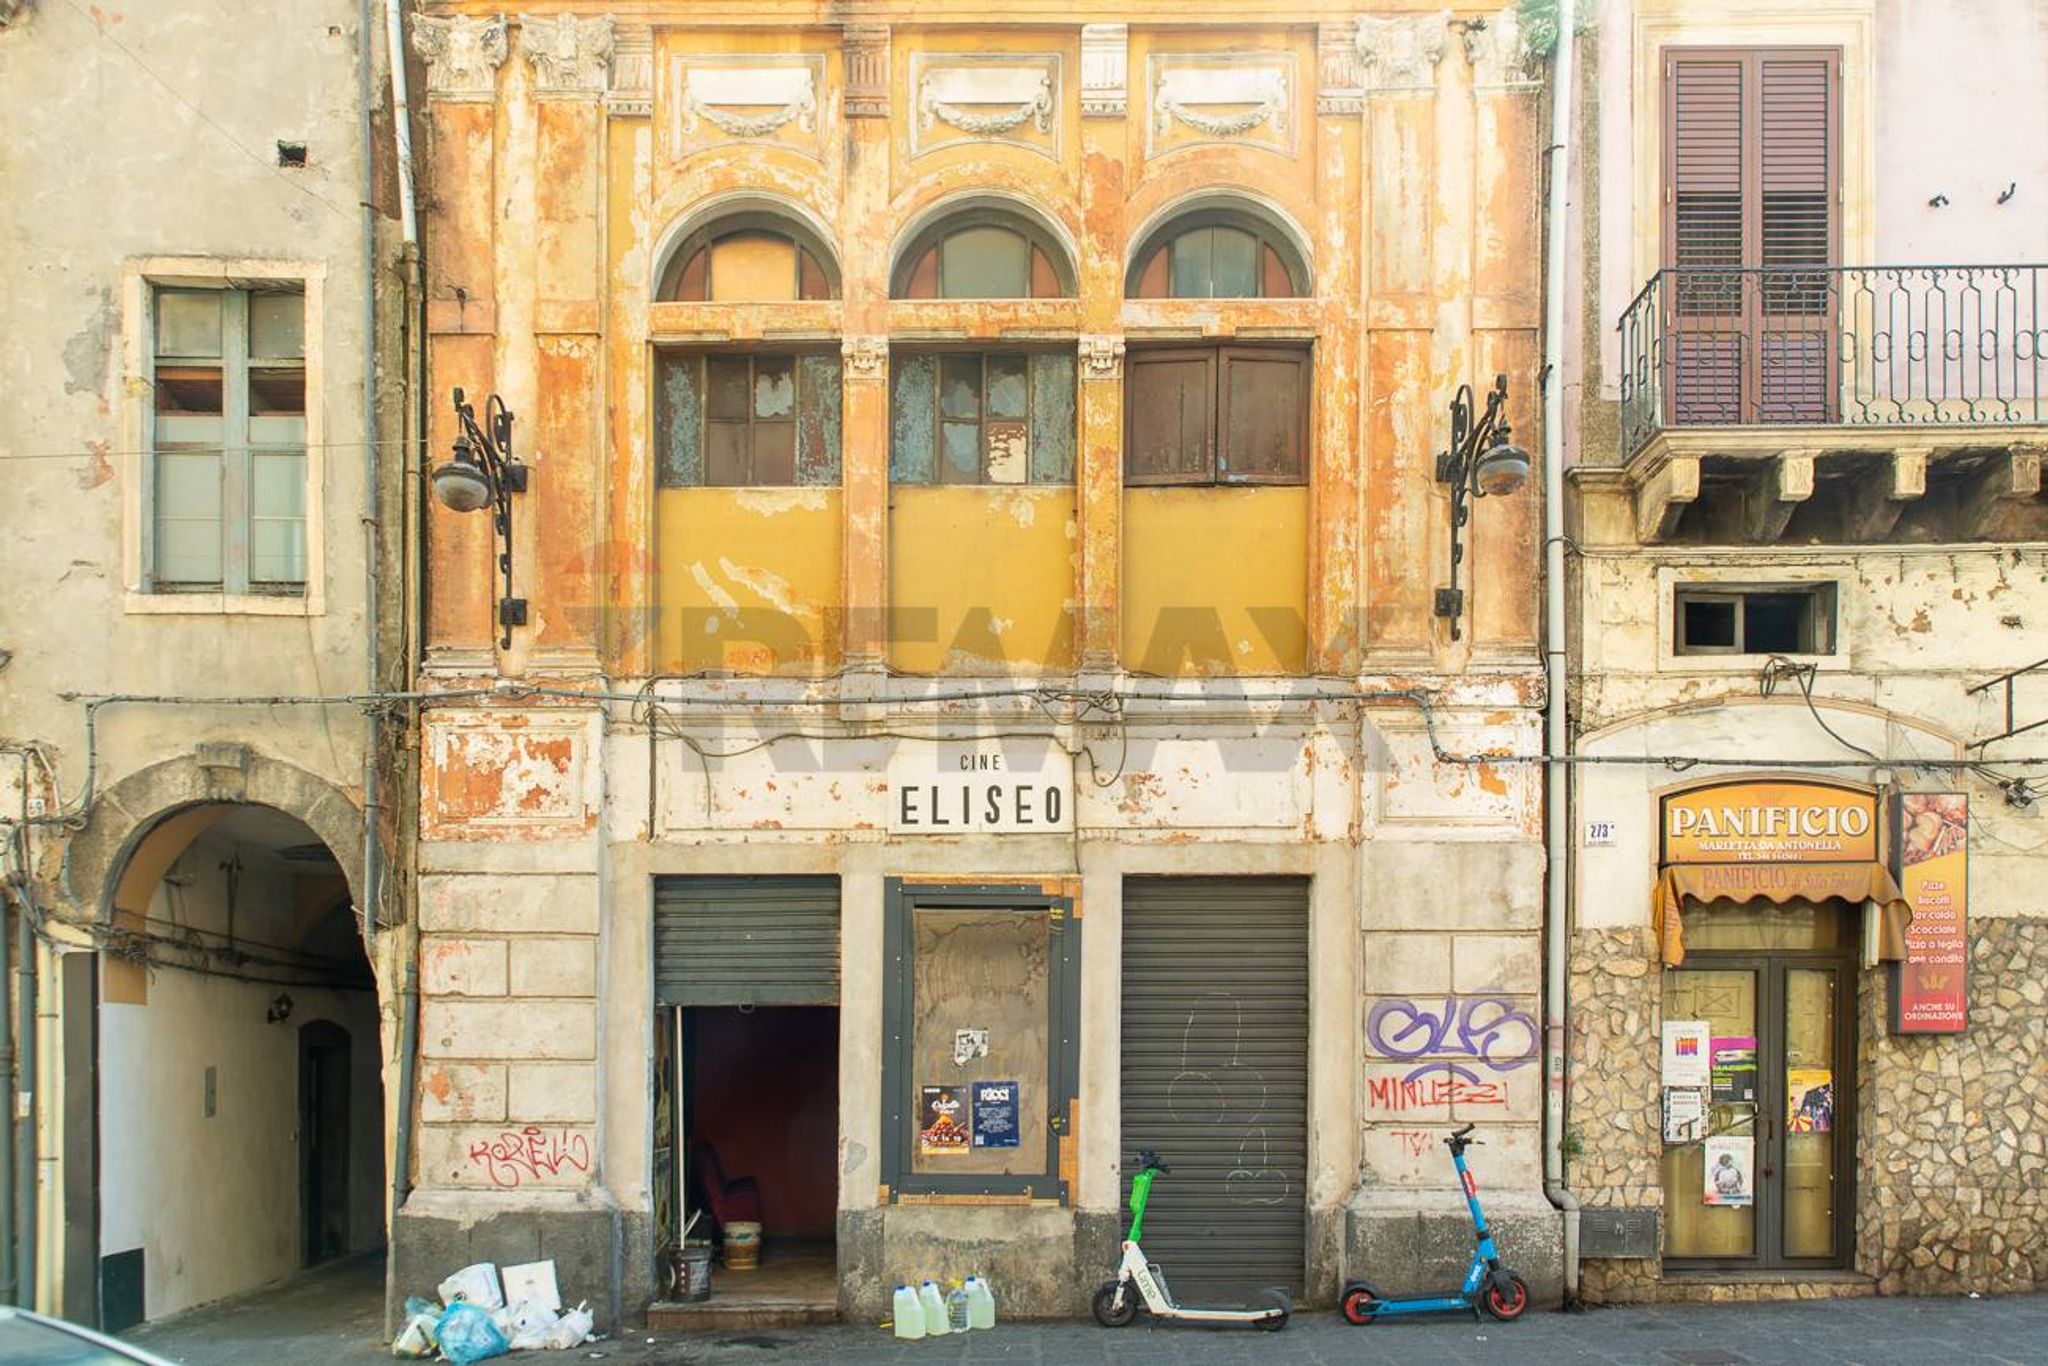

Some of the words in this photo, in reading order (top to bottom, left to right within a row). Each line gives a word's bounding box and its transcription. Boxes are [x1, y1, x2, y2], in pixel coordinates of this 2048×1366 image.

[960, 754, 1000, 771] CINE
[901, 785, 1061, 825] ELISEO
[1670, 806, 1870, 837] PANIFICIO
[1702, 866, 1787, 889] PANIFICIO
[1904, 1011, 1963, 1020] ORDINAZIONE
